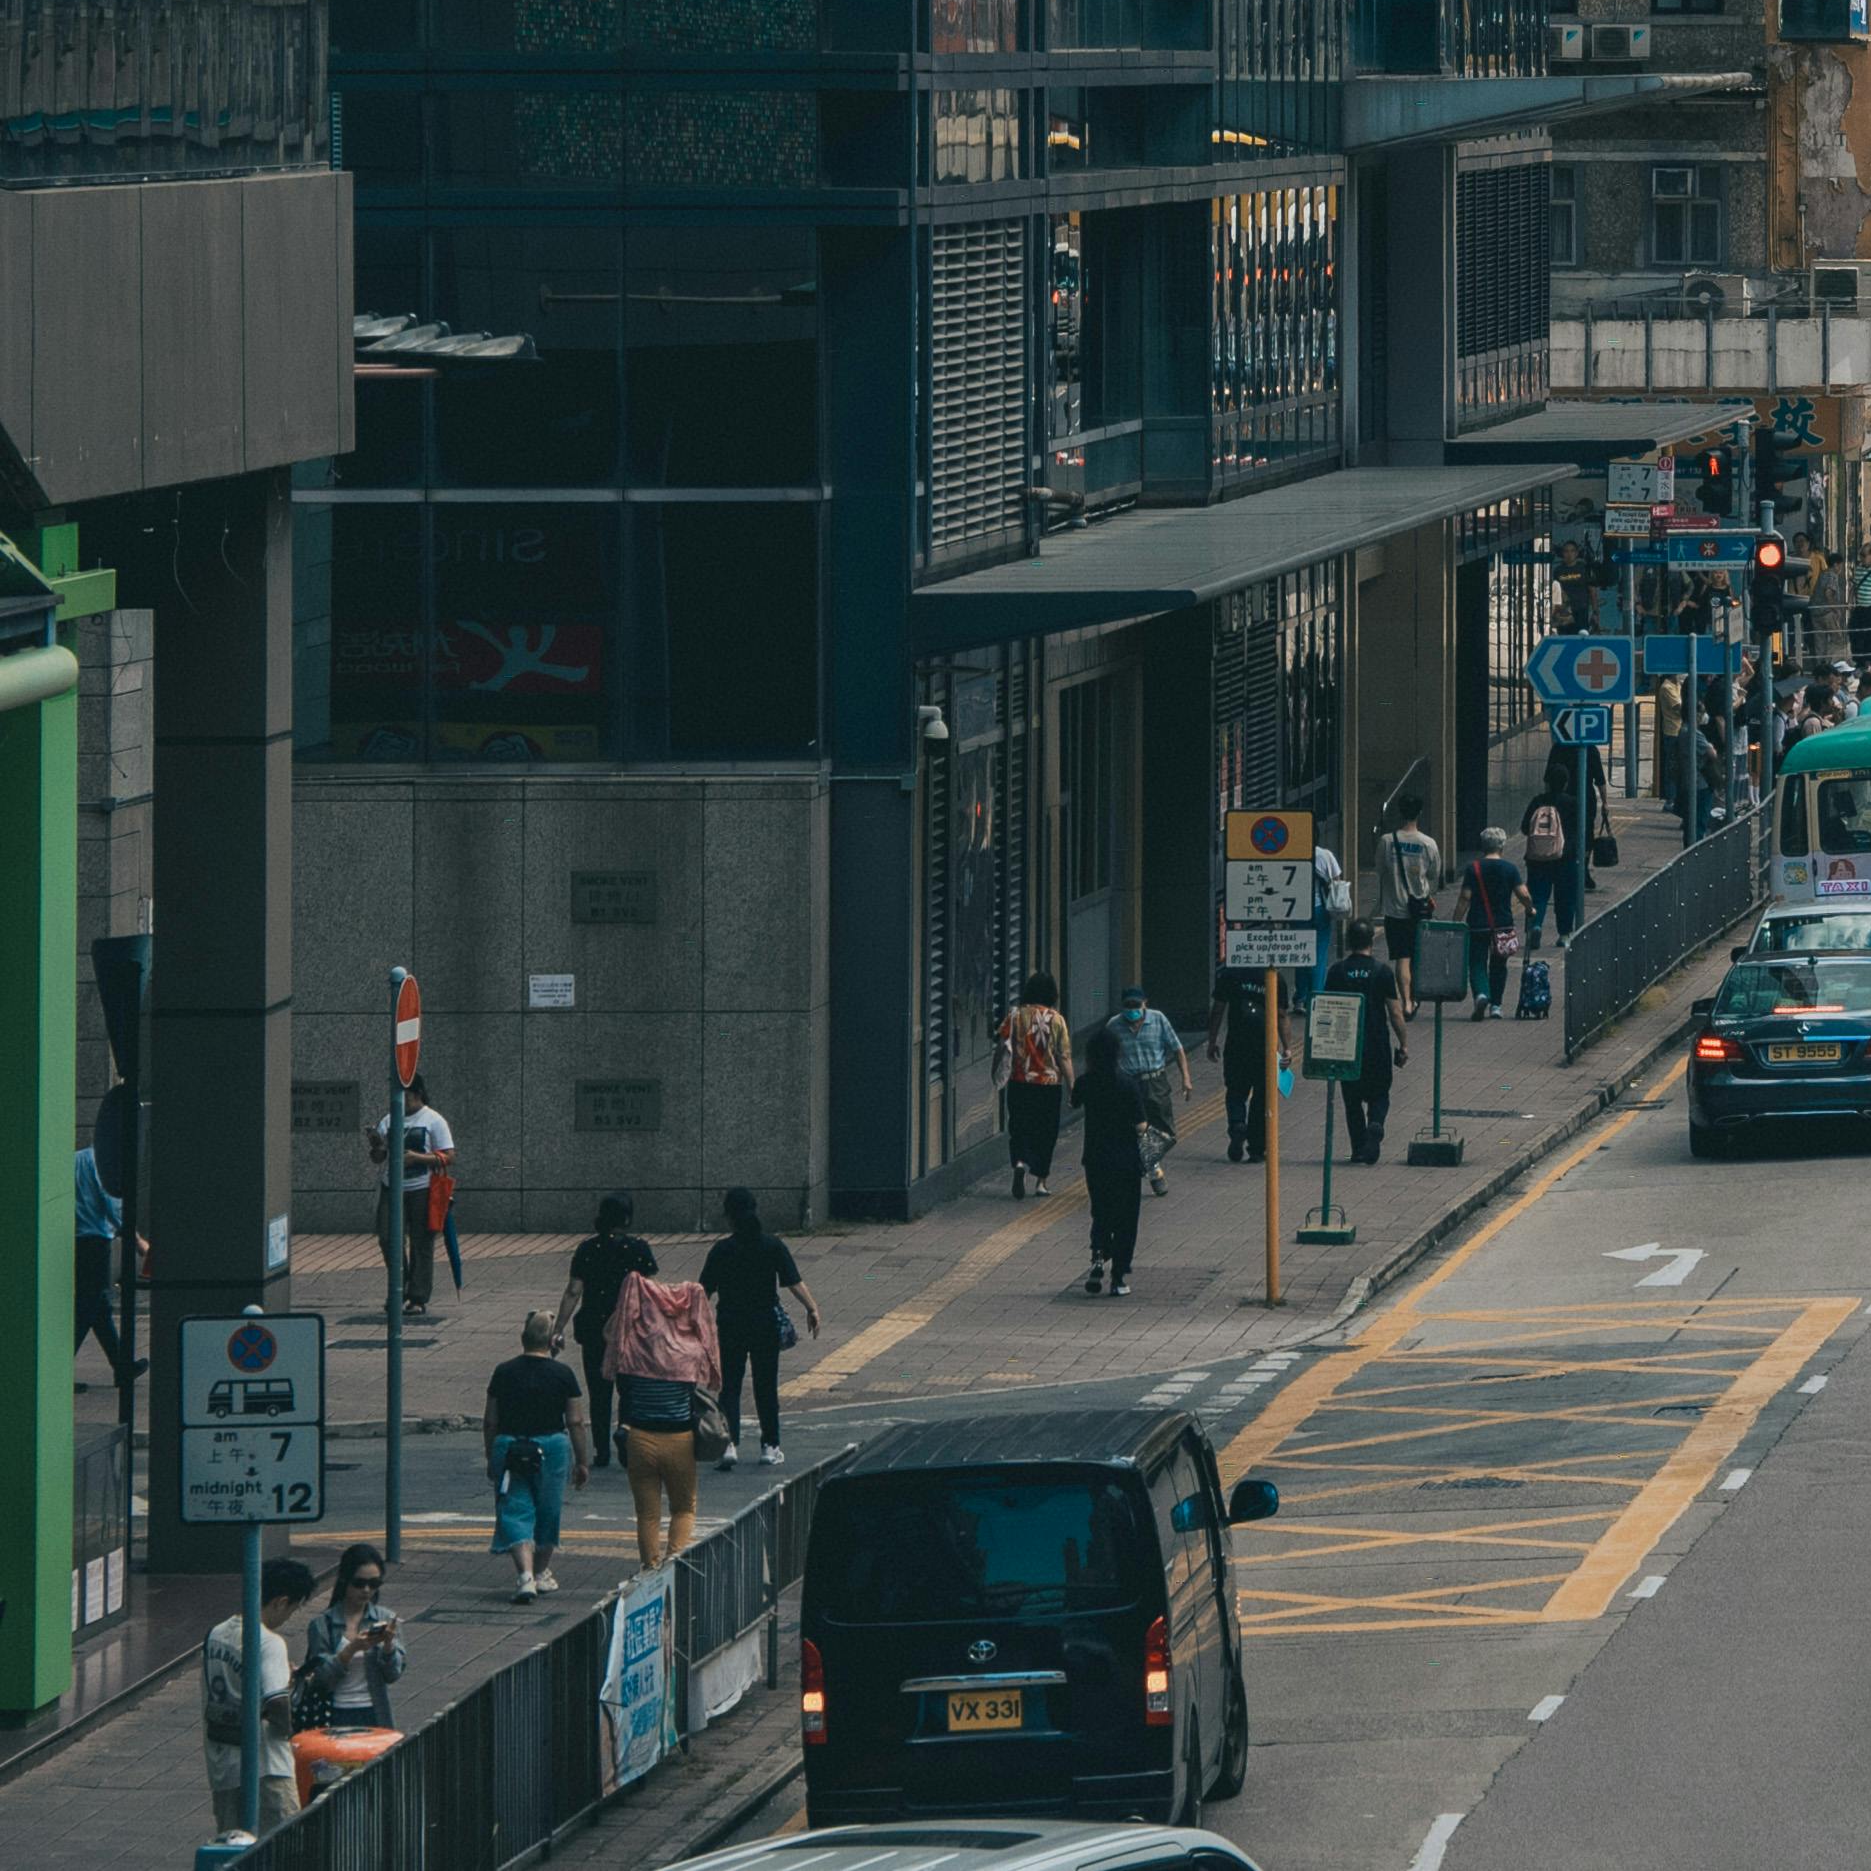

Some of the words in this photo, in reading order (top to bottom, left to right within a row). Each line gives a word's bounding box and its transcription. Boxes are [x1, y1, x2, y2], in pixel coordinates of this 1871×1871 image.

[1581, 714, 1599, 738] P
[1243, 873, 1269, 887] 上午
[1282, 865, 1297, 887] 7
[1820, 881, 1869, 893] TAXI
[1247, 897, 1264, 906] pm
[1282, 897, 1297, 918] 7
[1243, 905, 1269, 918] 下午
[1247, 932, 1278, 944] Except
[1280, 932, 1297, 942] taxi
[1235, 942, 1256, 953] pick
[1258, 942, 1288, 954] up/drop
[1290, 941, 1308, 951] off
[213, 1430, 239, 1443] am
[269, 1431, 293, 1463] 7
[206, 1448, 244, 1465] 上午
[189, 1480, 263, 1497] midnight
[271, 1482, 313, 1514] 12
[206, 1499, 246, 1516] 午夜
[952, 1699, 979, 1721] VX
[985, 1697, 1019, 1719] 331
